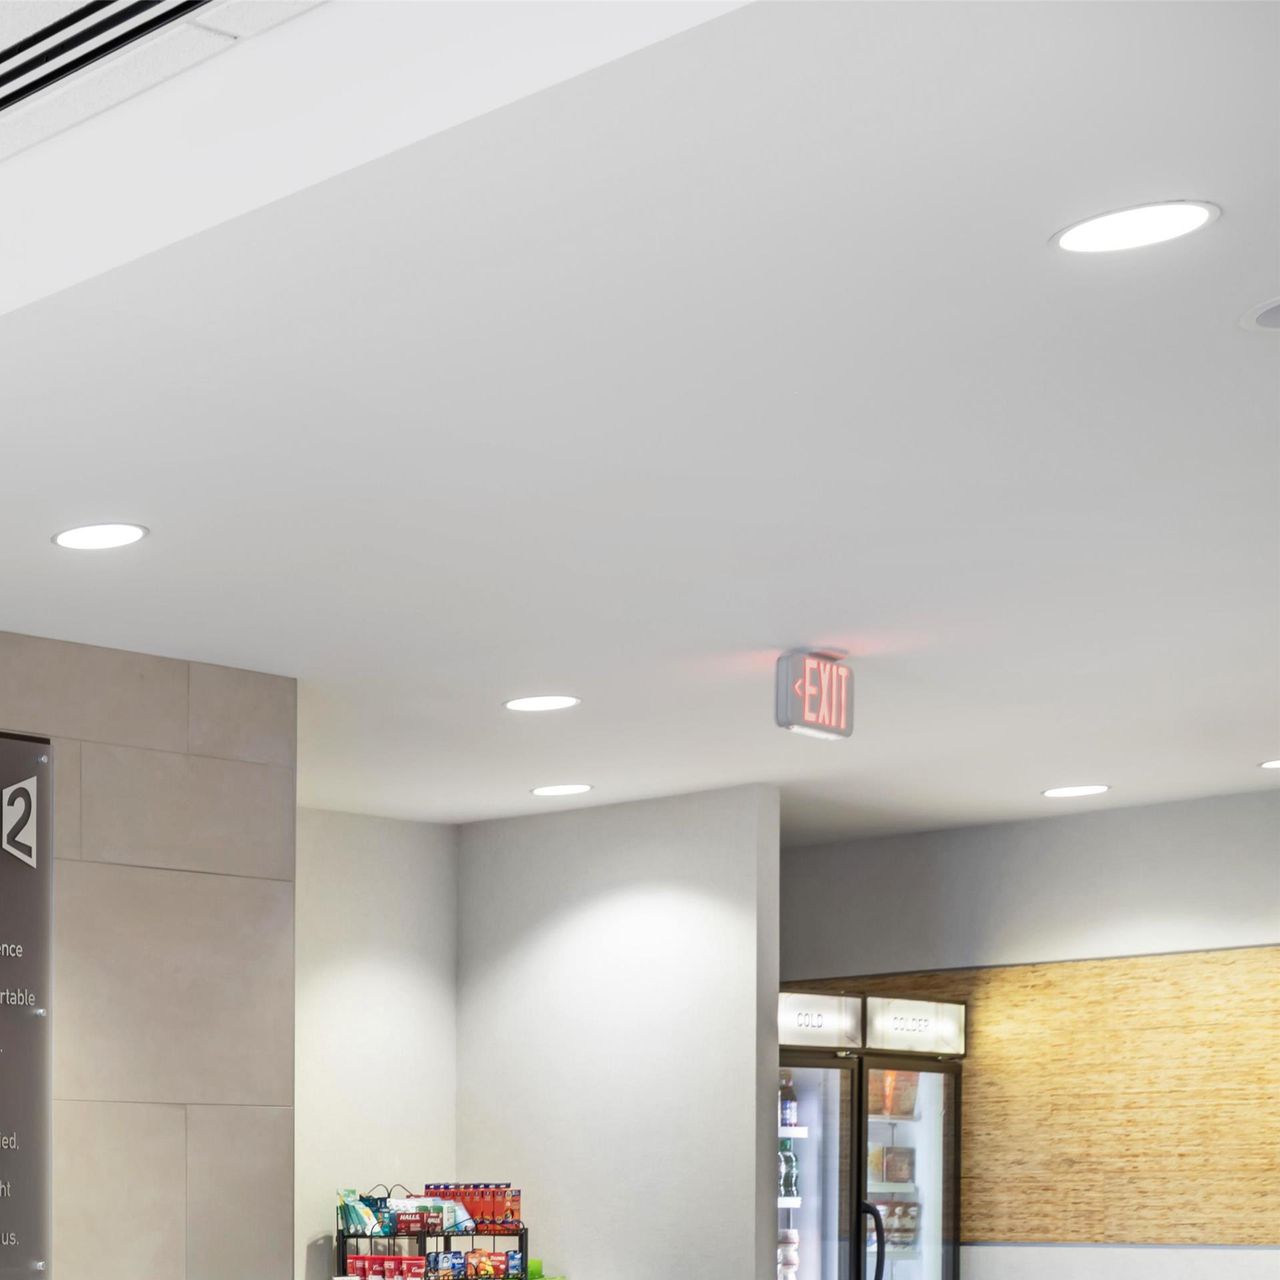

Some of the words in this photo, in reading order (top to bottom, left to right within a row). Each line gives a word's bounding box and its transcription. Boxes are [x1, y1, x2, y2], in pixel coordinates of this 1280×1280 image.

[803, 658, 848, 729] EXIT
[797, 1012, 823, 1029] COLD
[400, 1213, 421, 1221] HALLS
[1, 1232, 20, 1246] us.
